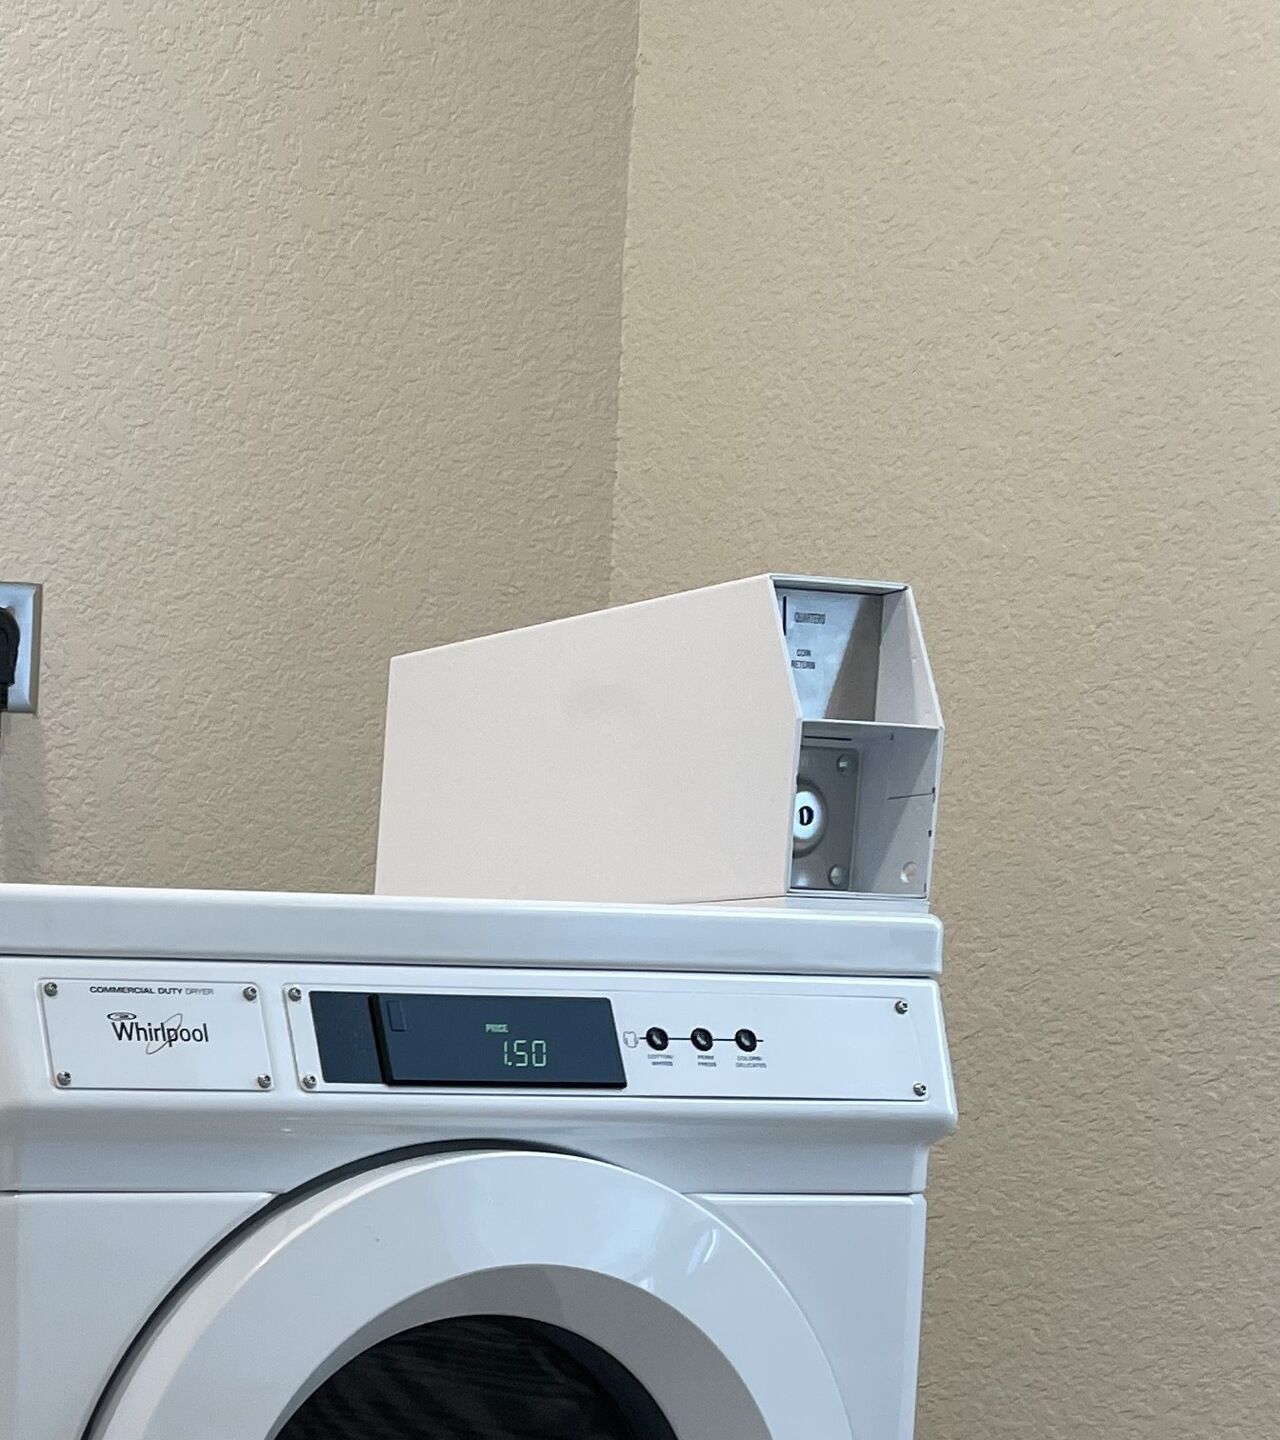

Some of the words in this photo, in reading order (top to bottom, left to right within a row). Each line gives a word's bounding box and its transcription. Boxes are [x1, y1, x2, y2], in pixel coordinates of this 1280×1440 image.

[89, 986, 155, 994] COMMERCIAL
[157, 987, 183, 995] DUTY
[111, 1021, 209, 1047] Whirlpool
[503, 1039, 547, 1067] 1.50
